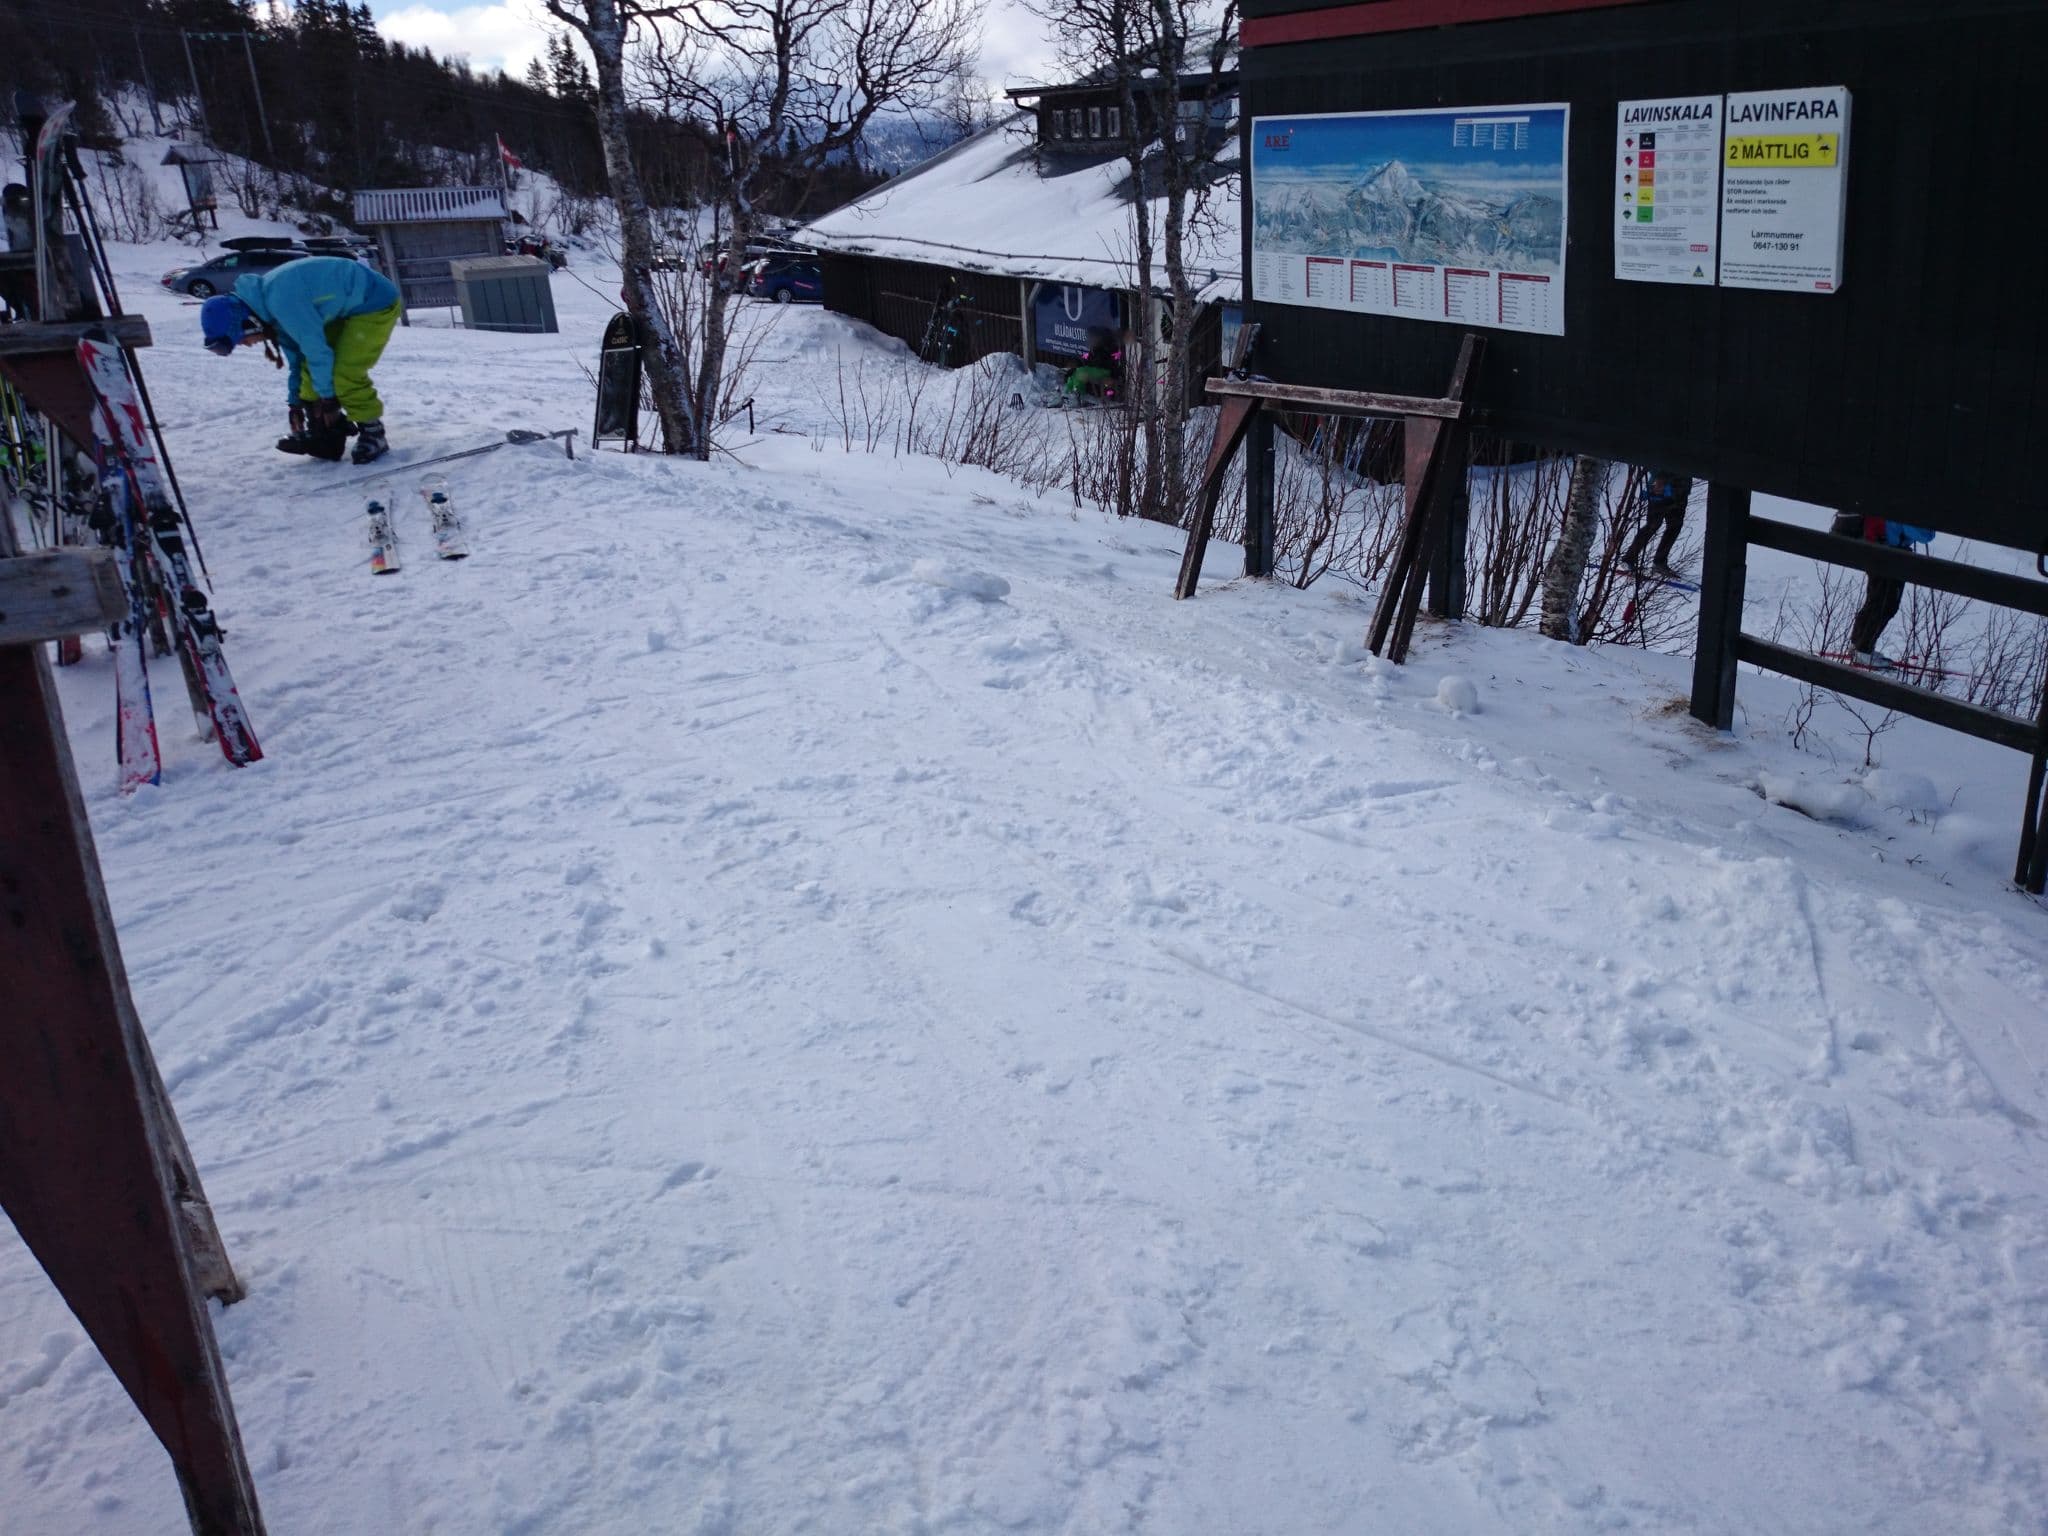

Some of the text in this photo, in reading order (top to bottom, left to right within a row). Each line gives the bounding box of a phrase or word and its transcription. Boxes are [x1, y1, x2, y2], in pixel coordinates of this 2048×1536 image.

[1624, 103, 1713, 123] LAVINSKALA
[1730, 99, 1839, 123] LAVINFARA
[1729, 139, 1809, 160] 2 MÅTTLIG
[1751, 230, 1804, 240] Larmnummer
[1753, 242, 1800, 252] 0647-130 91
